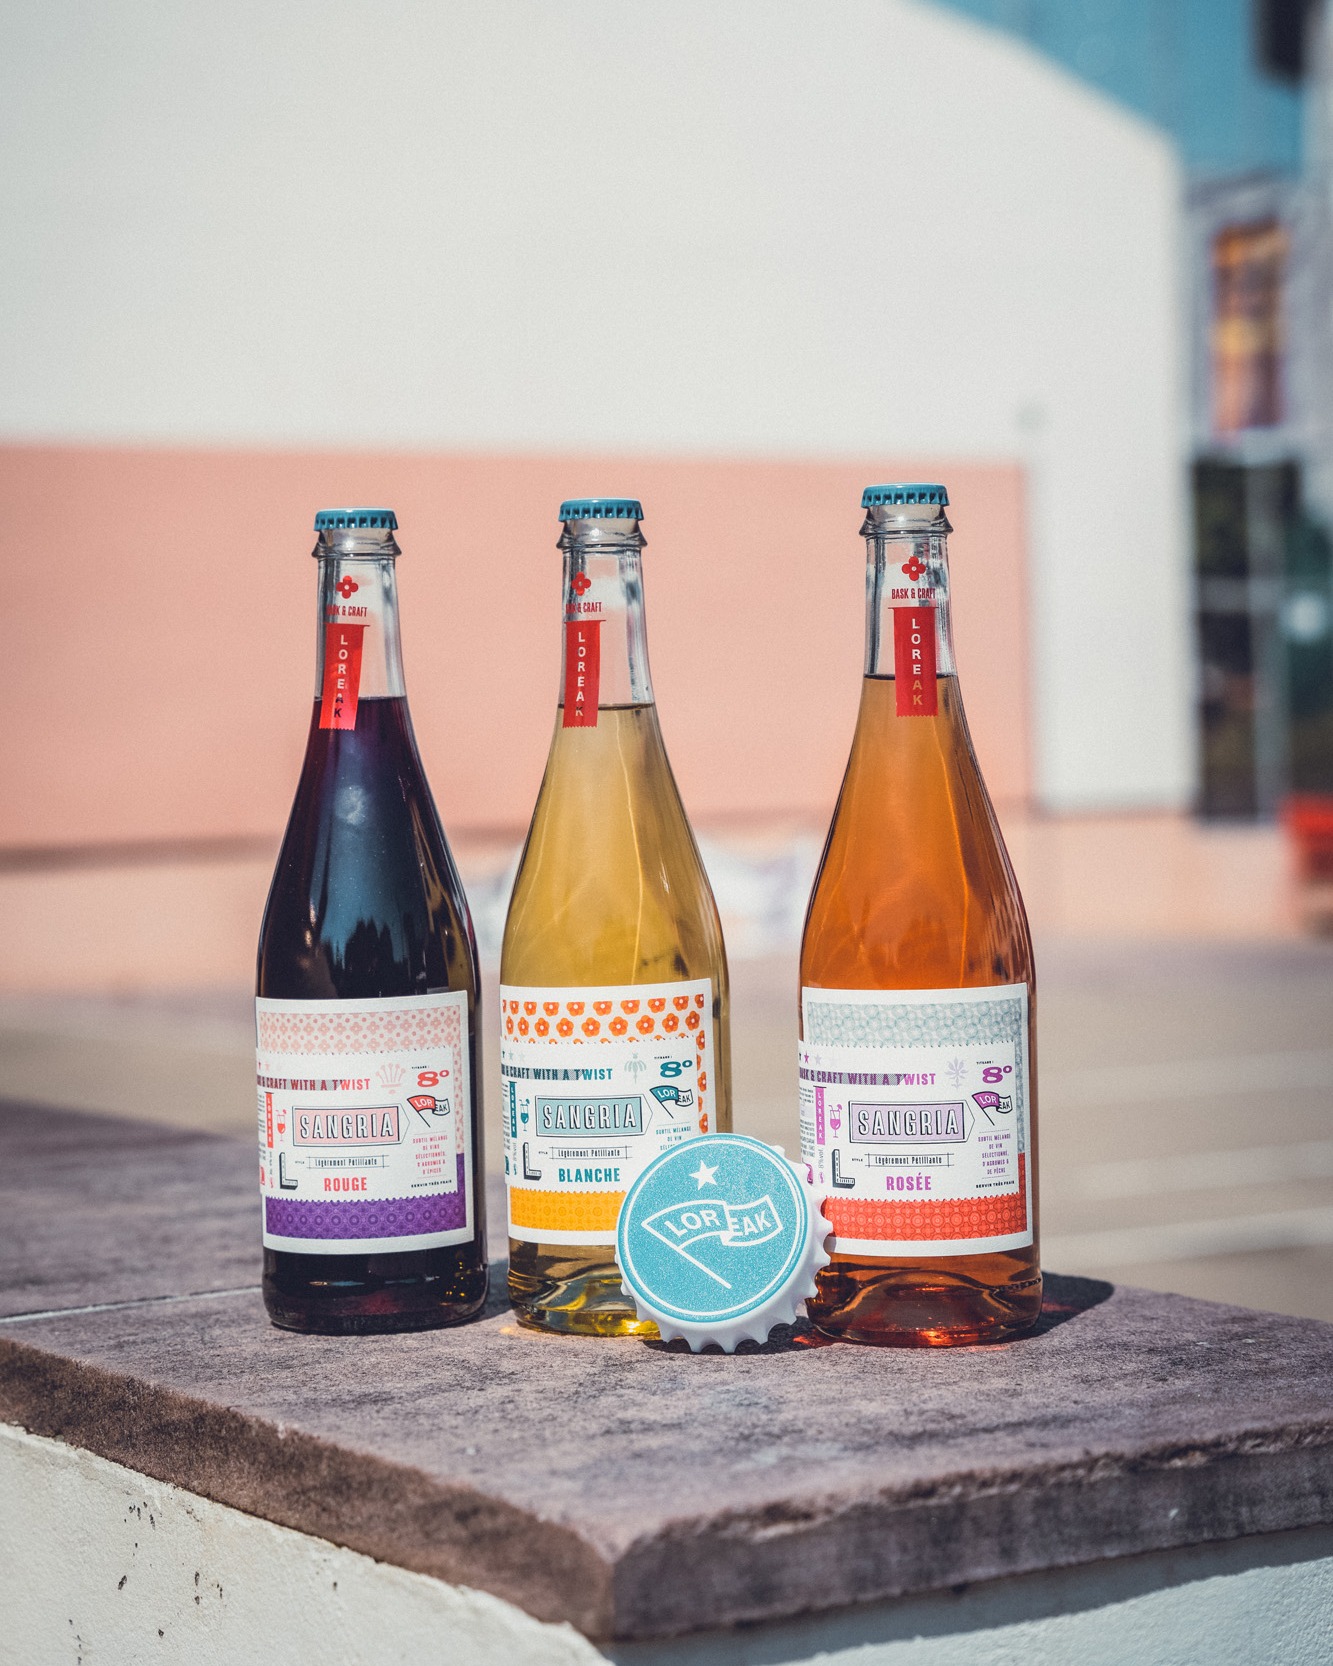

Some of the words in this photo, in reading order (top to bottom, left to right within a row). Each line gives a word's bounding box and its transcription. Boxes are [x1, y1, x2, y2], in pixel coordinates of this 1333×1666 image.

[892, 588, 909, 599] BASK
[911, 588, 916, 599] &
[917, 588, 936, 599] CRAFT
[342, 605, 346, 616] &
[348, 605, 368, 617] CRAFT
[583, 602, 602, 613] CRAFT
[911, 618, 923, 705] LOREAK
[334, 635, 348, 718] LOREAK
[575, 632, 586, 716] LOREAK
[510, 1066, 530, 1079] CRAFT
[533, 1068, 558, 1080] WITH
[562, 1069, 570, 1080] A
[574, 1068, 612, 1080] TWIST
[810, 1070, 814, 1082] &
[816, 1070, 843, 1084] CRAFT
[848, 1073, 876, 1085] WITH
[882, 1074, 890, 1085] A
[896, 1073, 936, 1085] TWIST
[266, 1077, 287, 1089] CRAFT
[290, 1080, 316, 1090] WITH
[320, 1080, 327, 1090] A
[332, 1079, 370, 1090] TWIST
[543, 1103, 636, 1129] SANGRIA
[858, 1109, 958, 1136] SANGRIA
[300, 1113, 394, 1139] SANGRIA
[558, 1168, 620, 1182] BLANCHE
[886, 1172, 932, 1190] ROSÉE
[324, 1177, 367, 1191] ROUGE
